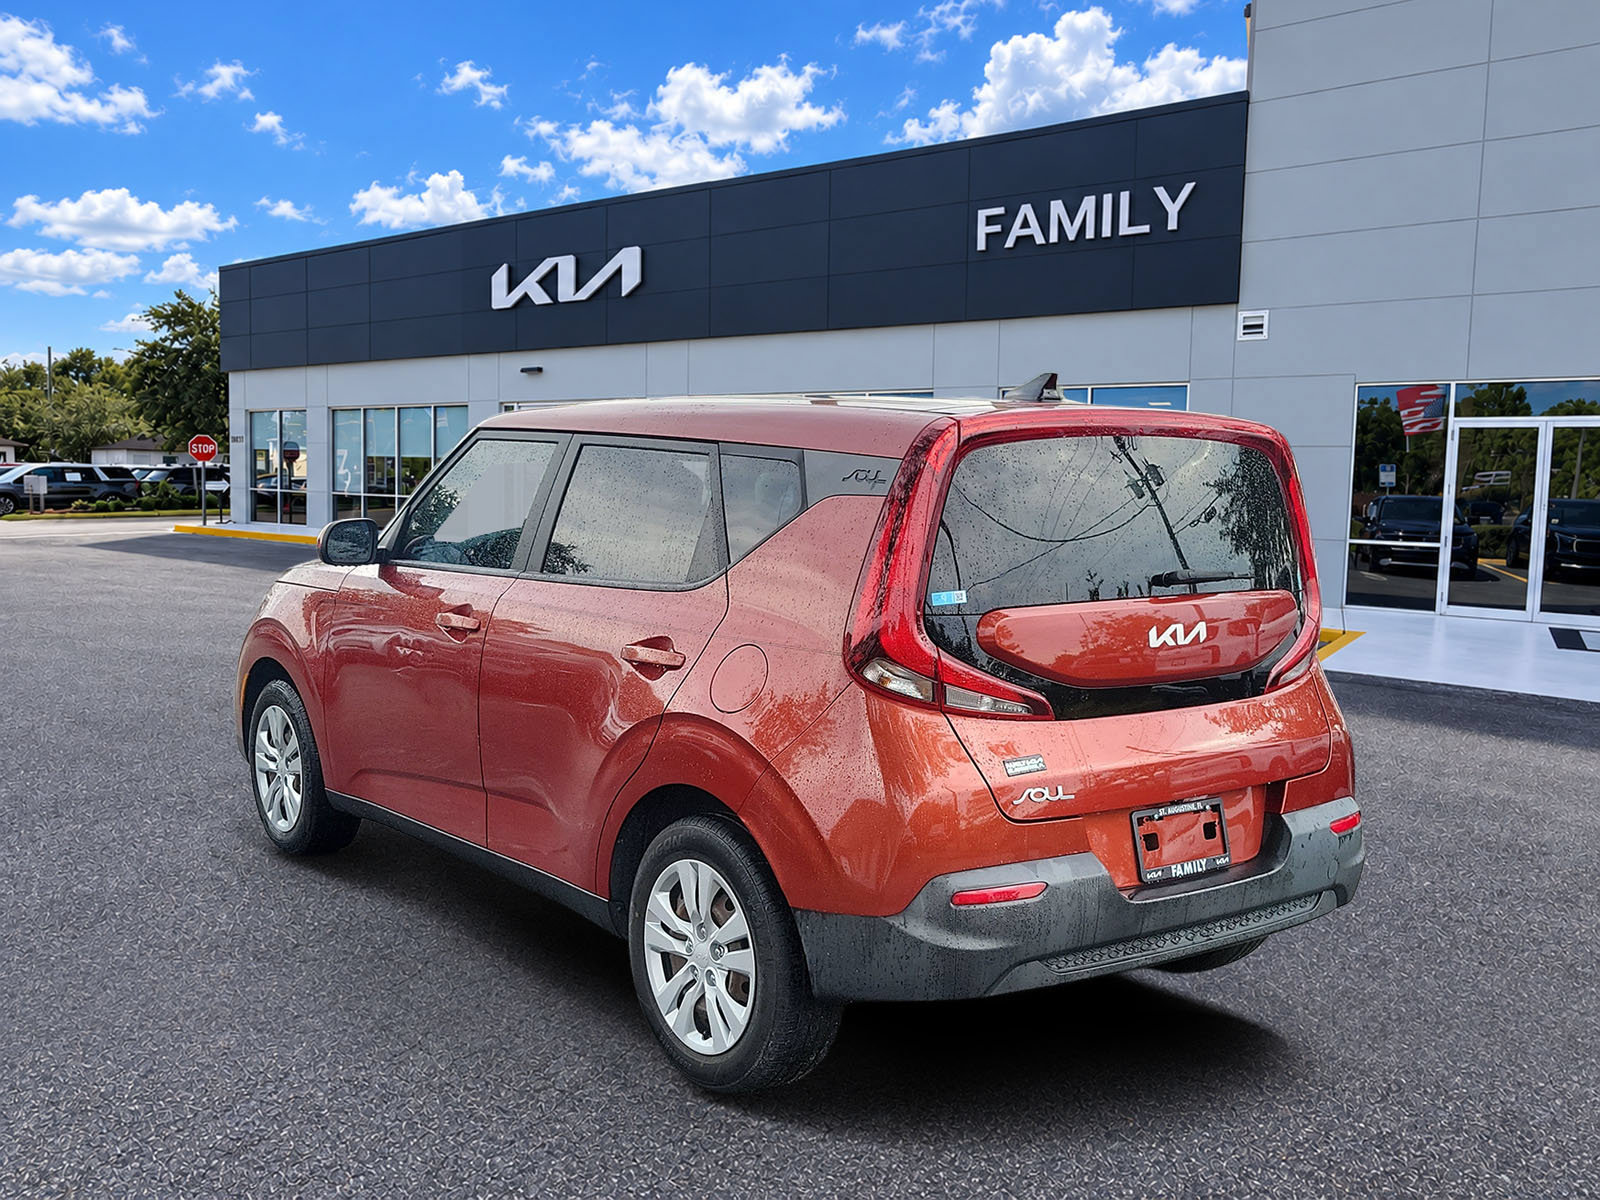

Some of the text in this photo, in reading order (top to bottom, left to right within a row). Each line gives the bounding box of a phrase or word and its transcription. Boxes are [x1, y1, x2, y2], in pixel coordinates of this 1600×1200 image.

[976, 181, 1197, 251] FAMILY
[491, 246, 642, 310] KIA
[191, 443, 215, 454] STOP
[1148, 621, 1207, 648] KIA
[1012, 785, 1075, 805] SOUL
[1171, 858, 1207, 878] FAMILY
